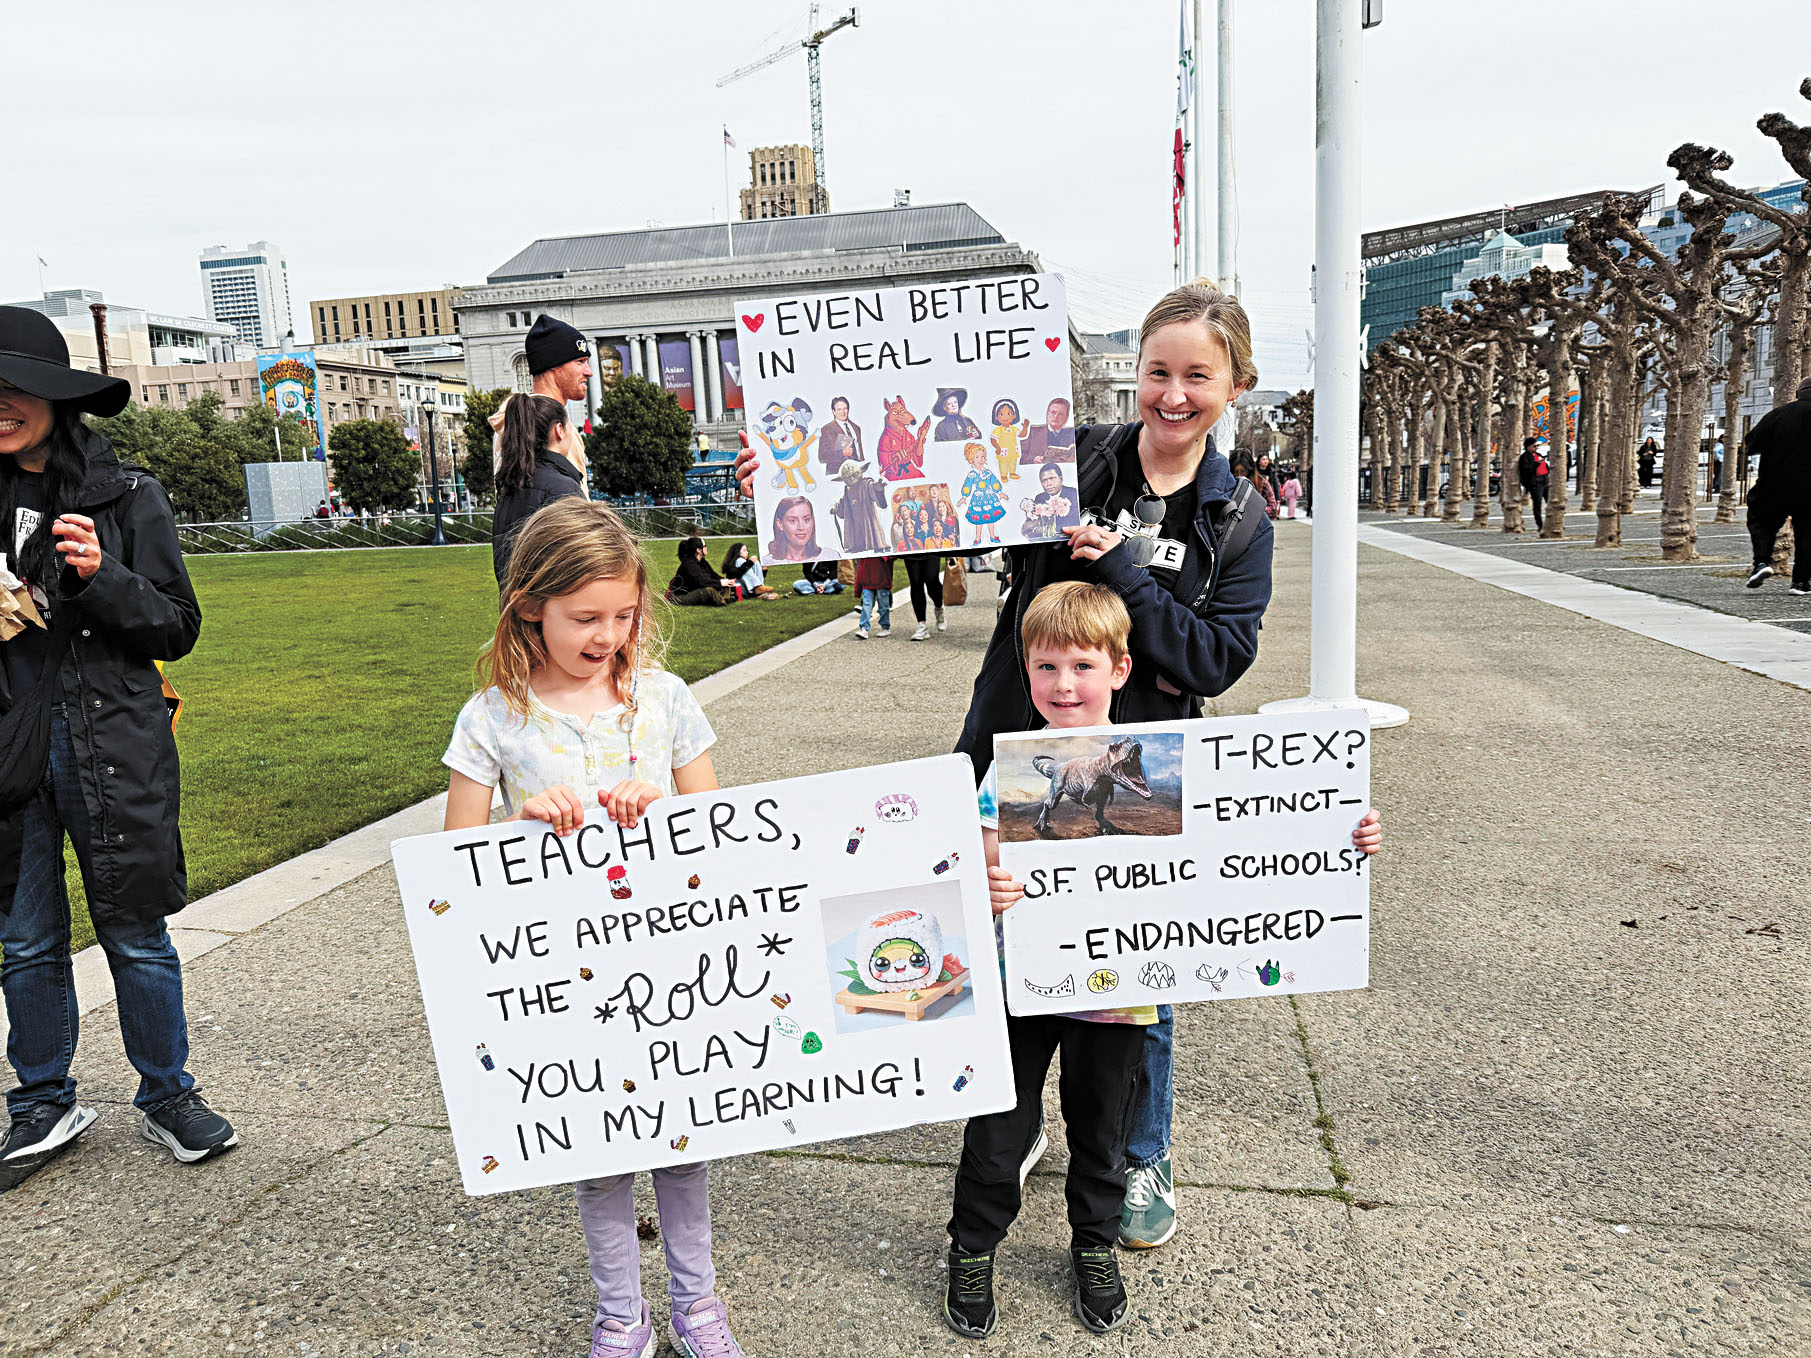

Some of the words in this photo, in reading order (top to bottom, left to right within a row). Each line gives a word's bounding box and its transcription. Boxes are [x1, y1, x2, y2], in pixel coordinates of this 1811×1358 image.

[775, 292, 885, 336] EVEN
[908, 278, 1049, 323] BETTER
[664, 366, 685, 374] Asian
[664, 374, 675, 382] Art
[758, 348, 796, 379] IN
[829, 338, 932, 374] REAL
[953, 327, 1036, 364] LIFE
[665, 381, 692, 390] Museum
[1201, 729, 1366, 770] T-REX?
[453, 798, 802, 887] TEACHERS,
[1022, 866, 1077, 899] S.F.
[1095, 859, 1198, 892] PUBLIC
[1219, 848, 1369, 880] SCHOOLS?
[479, 920, 550, 965] WE
[576, 883, 809, 950] APPRECIATE
[486, 978, 572, 1022] THE
[507, 1057, 606, 1104] YOU
[649, 1024, 771, 1081] PLAY
[516, 1115, 573, 1161] IN
[603, 1099, 665, 1143] MY
[689, 1056, 926, 1128] LEARNING!
[959, 1255, 990, 1264] SKECHERS
